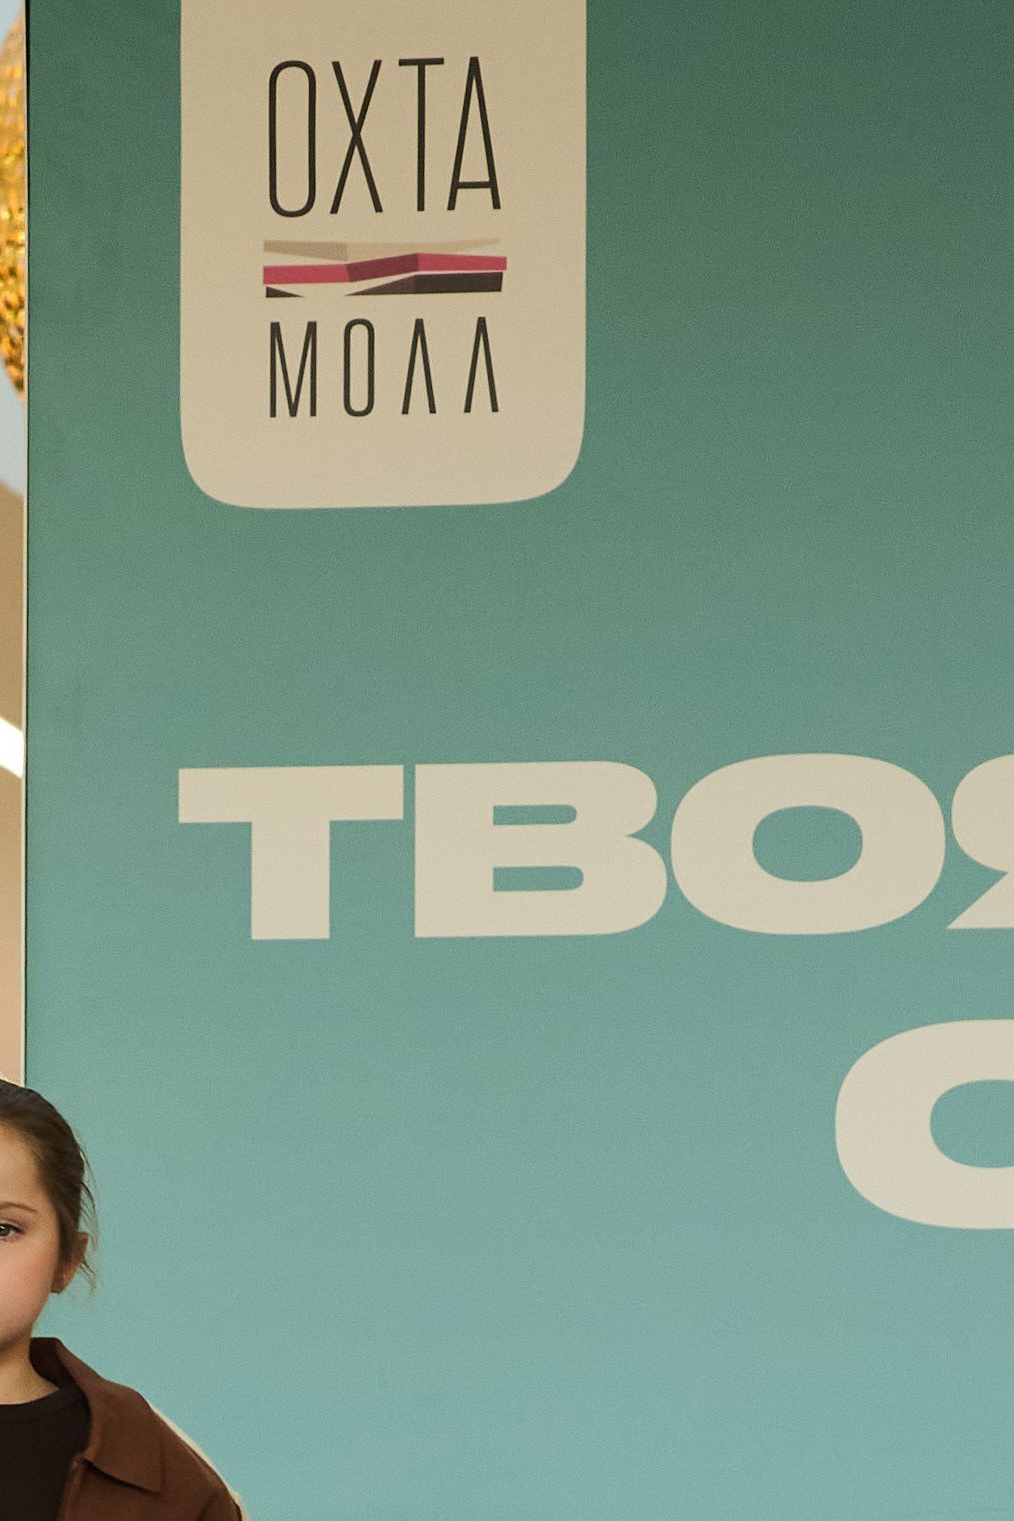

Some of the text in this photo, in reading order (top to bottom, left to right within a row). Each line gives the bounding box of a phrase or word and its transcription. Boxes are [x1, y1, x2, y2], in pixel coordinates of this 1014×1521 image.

[269, 56, 501, 217] ОХТА
[270, 316, 499, 418] МОЛЛ
[178, 753, 1014, 940] ТВО
